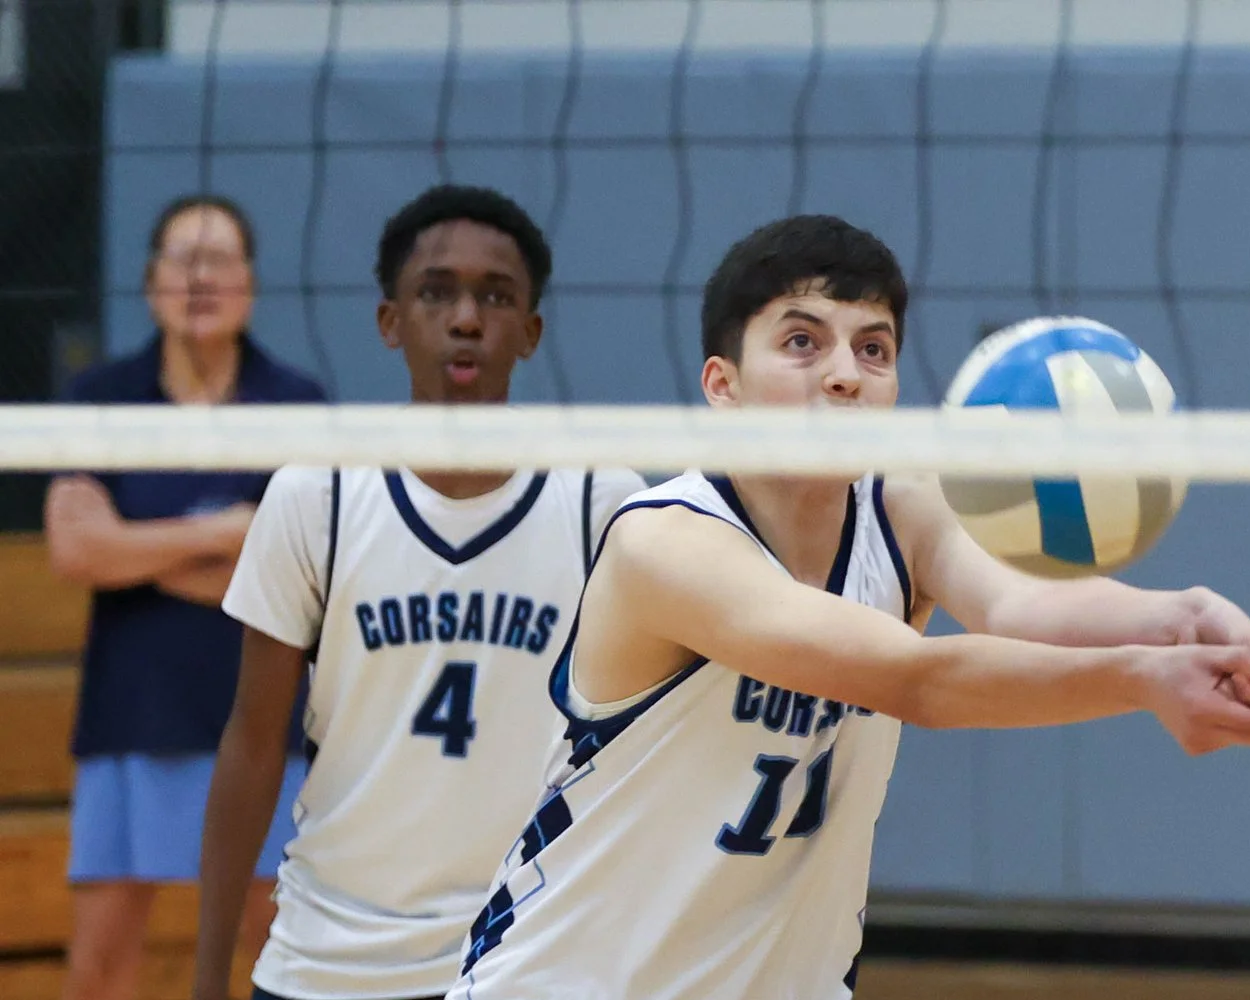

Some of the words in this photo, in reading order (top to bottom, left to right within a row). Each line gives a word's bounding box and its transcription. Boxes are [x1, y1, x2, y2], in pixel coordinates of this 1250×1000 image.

[355, 591, 559, 655] CORSAIRS
[411, 661, 477, 758] 4
[715, 743, 834, 856] 11
